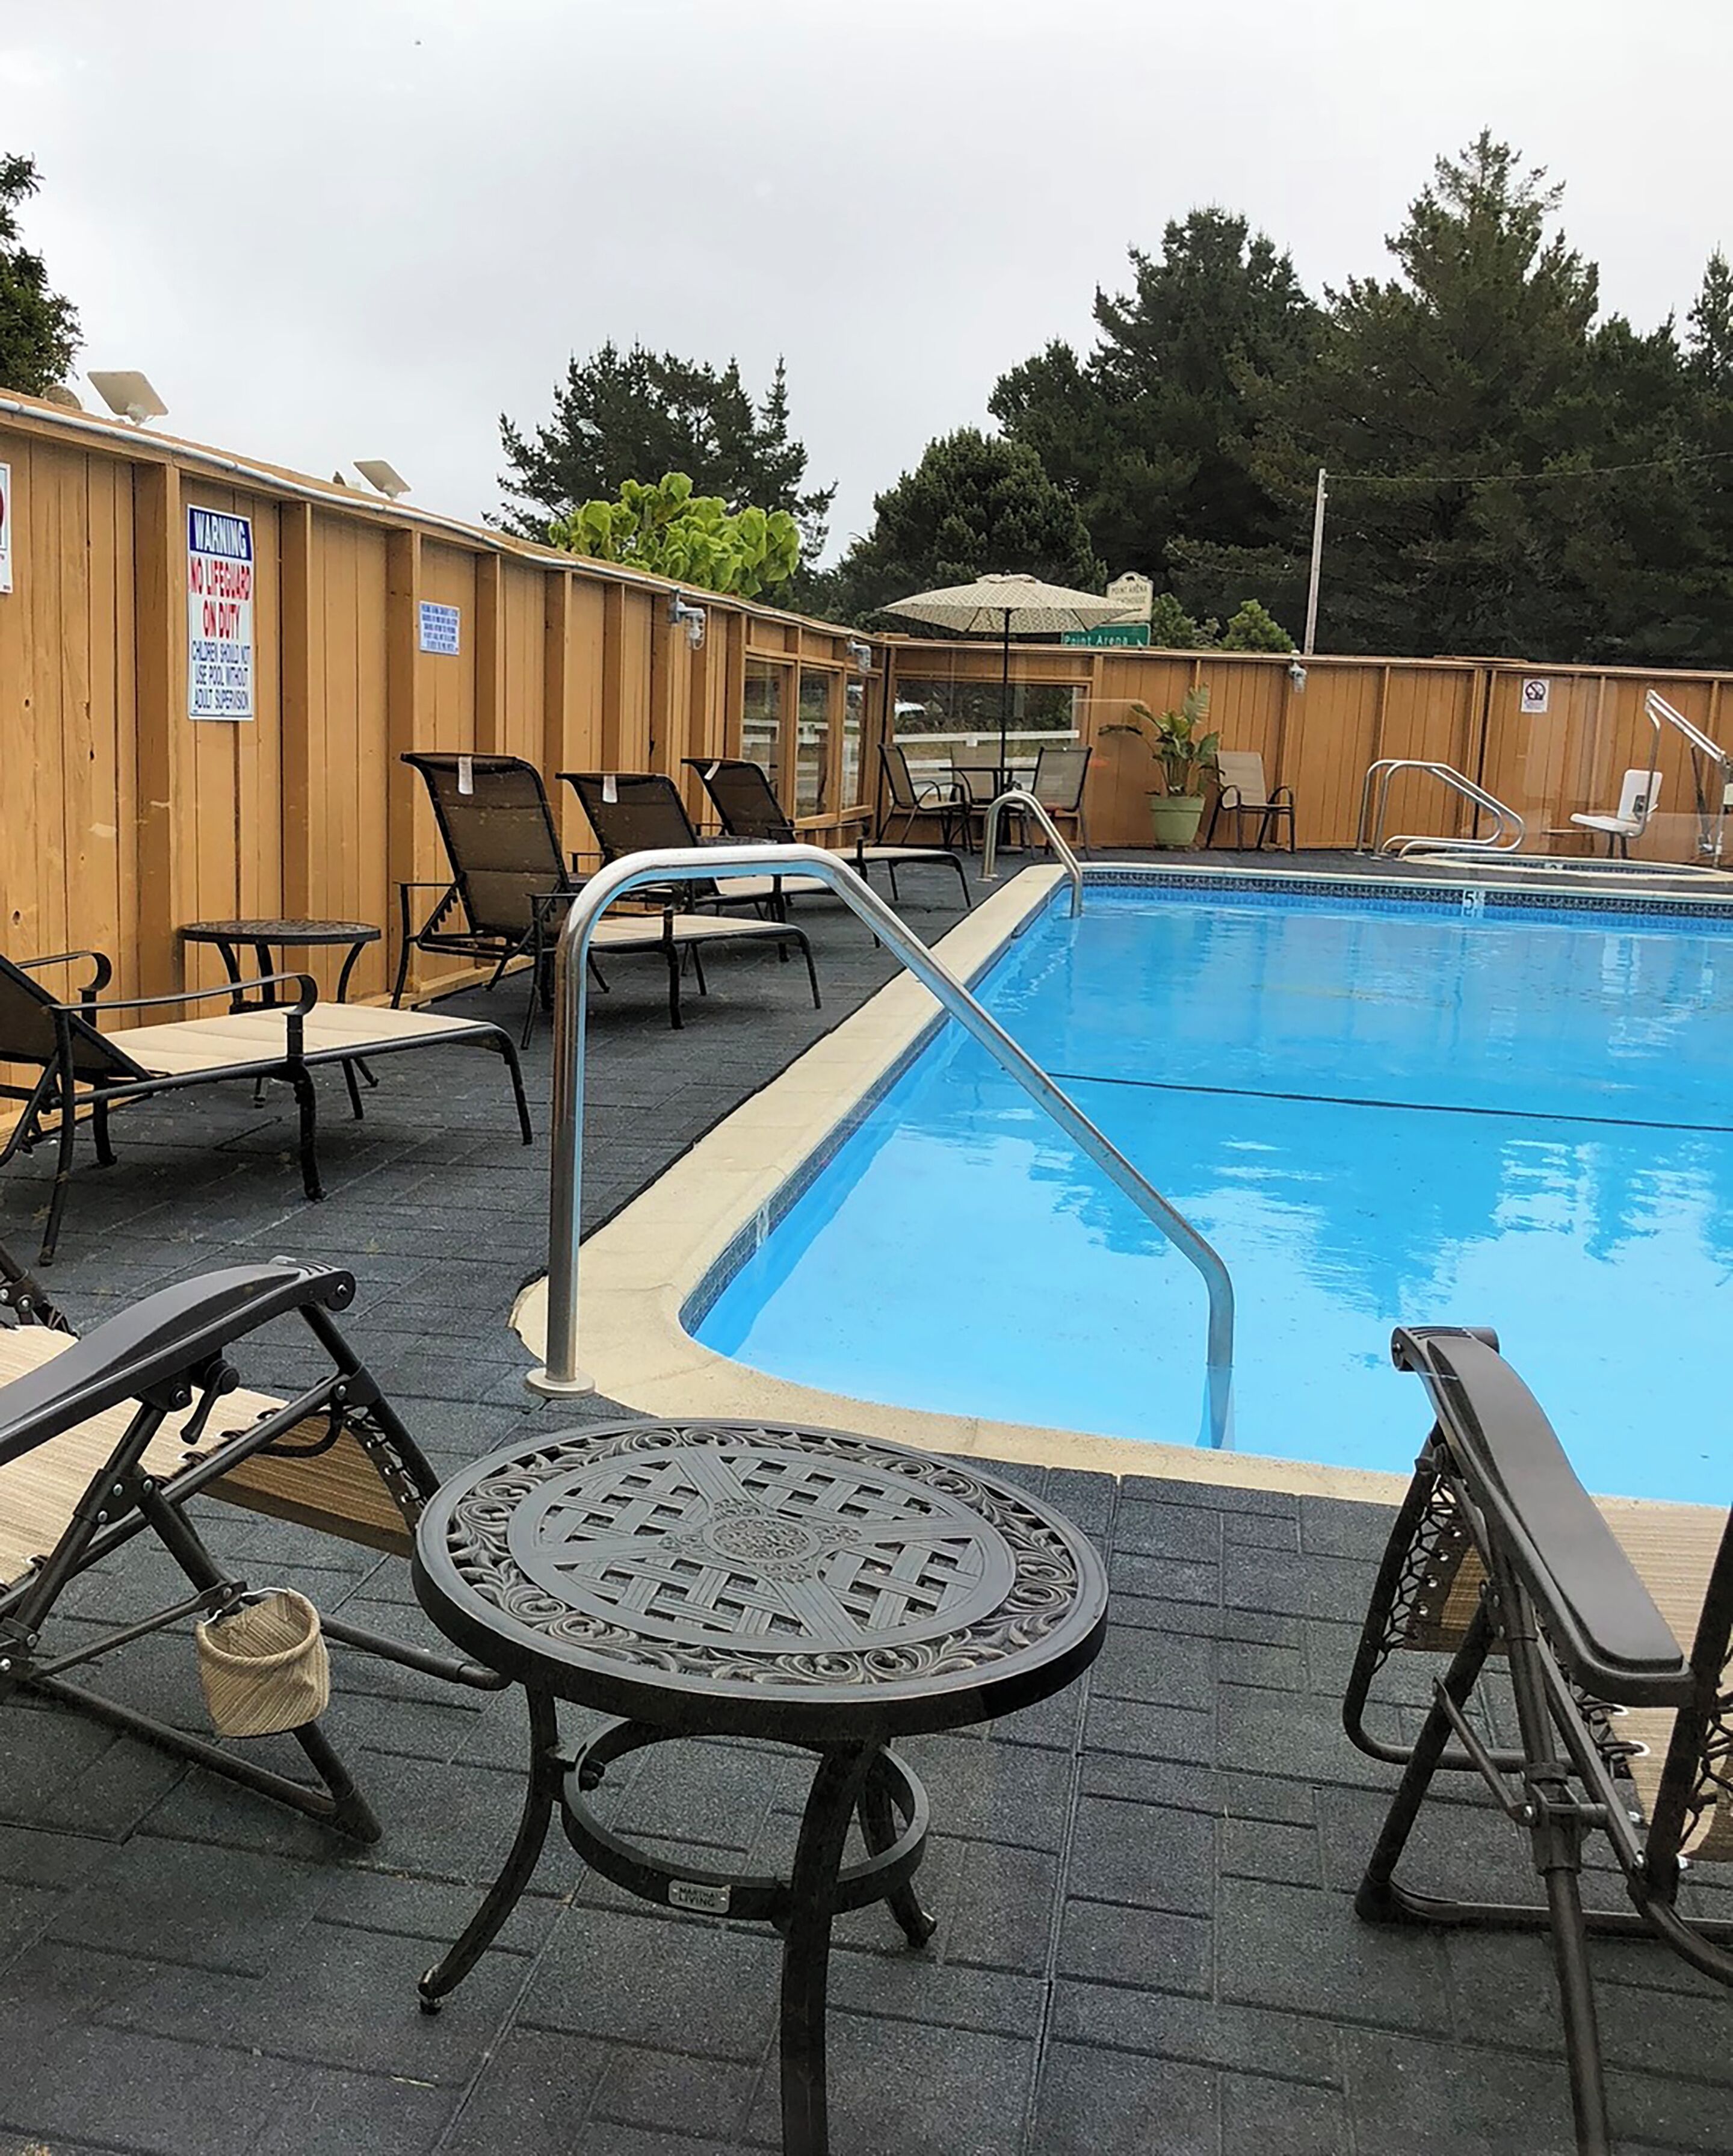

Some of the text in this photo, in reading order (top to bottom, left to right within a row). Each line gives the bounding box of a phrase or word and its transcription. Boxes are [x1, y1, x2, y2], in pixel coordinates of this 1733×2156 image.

[194, 511, 247, 558] WARNING
[191, 556, 252, 600] NO LIFEGUARD
[1111, 586, 1128, 595] POINT
[203, 600, 241, 639] ON DUTY
[192, 640, 250, 664] CHILDREN SHOULD NOT
[1064, 634, 1128, 646] Point Arena
[196, 663, 248, 687] USE POOL WITHOUT
[194, 688, 249, 710] ADULT SUPERVISION
[679, 1892, 715, 1907] LIVING
